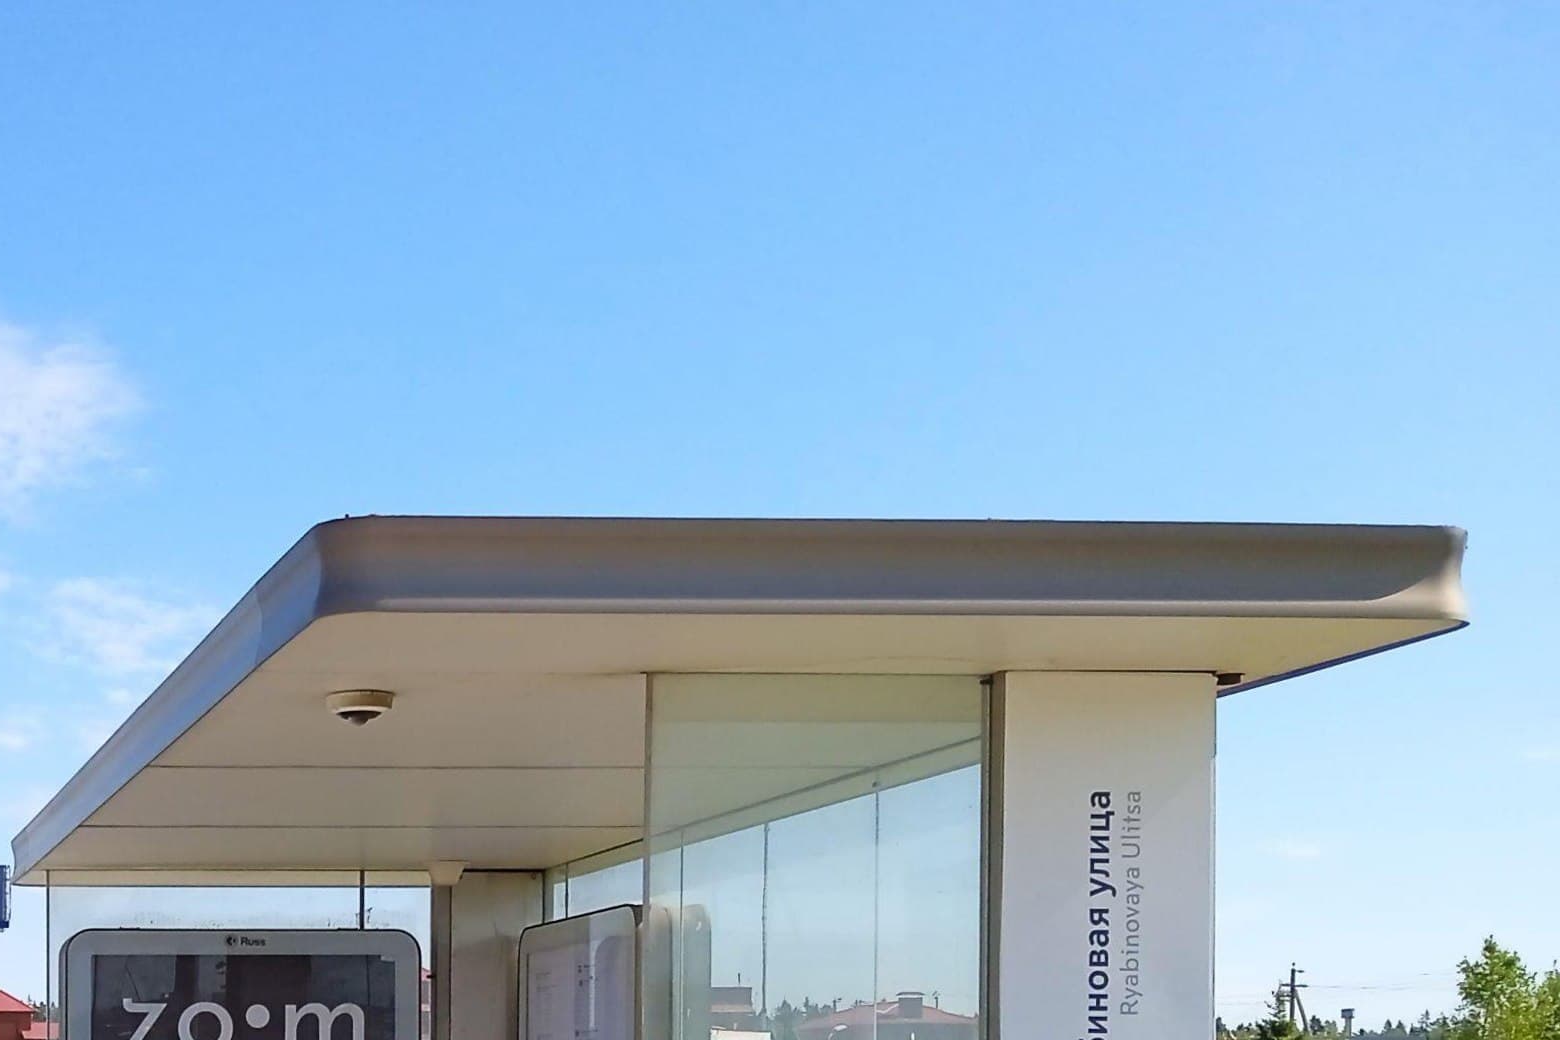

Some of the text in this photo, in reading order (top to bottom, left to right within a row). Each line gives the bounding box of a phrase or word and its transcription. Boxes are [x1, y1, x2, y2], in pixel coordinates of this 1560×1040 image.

[1089, 791, 1116, 897] улица
[1120, 791, 1144, 1015] Ryabinovaya Ulitsa
